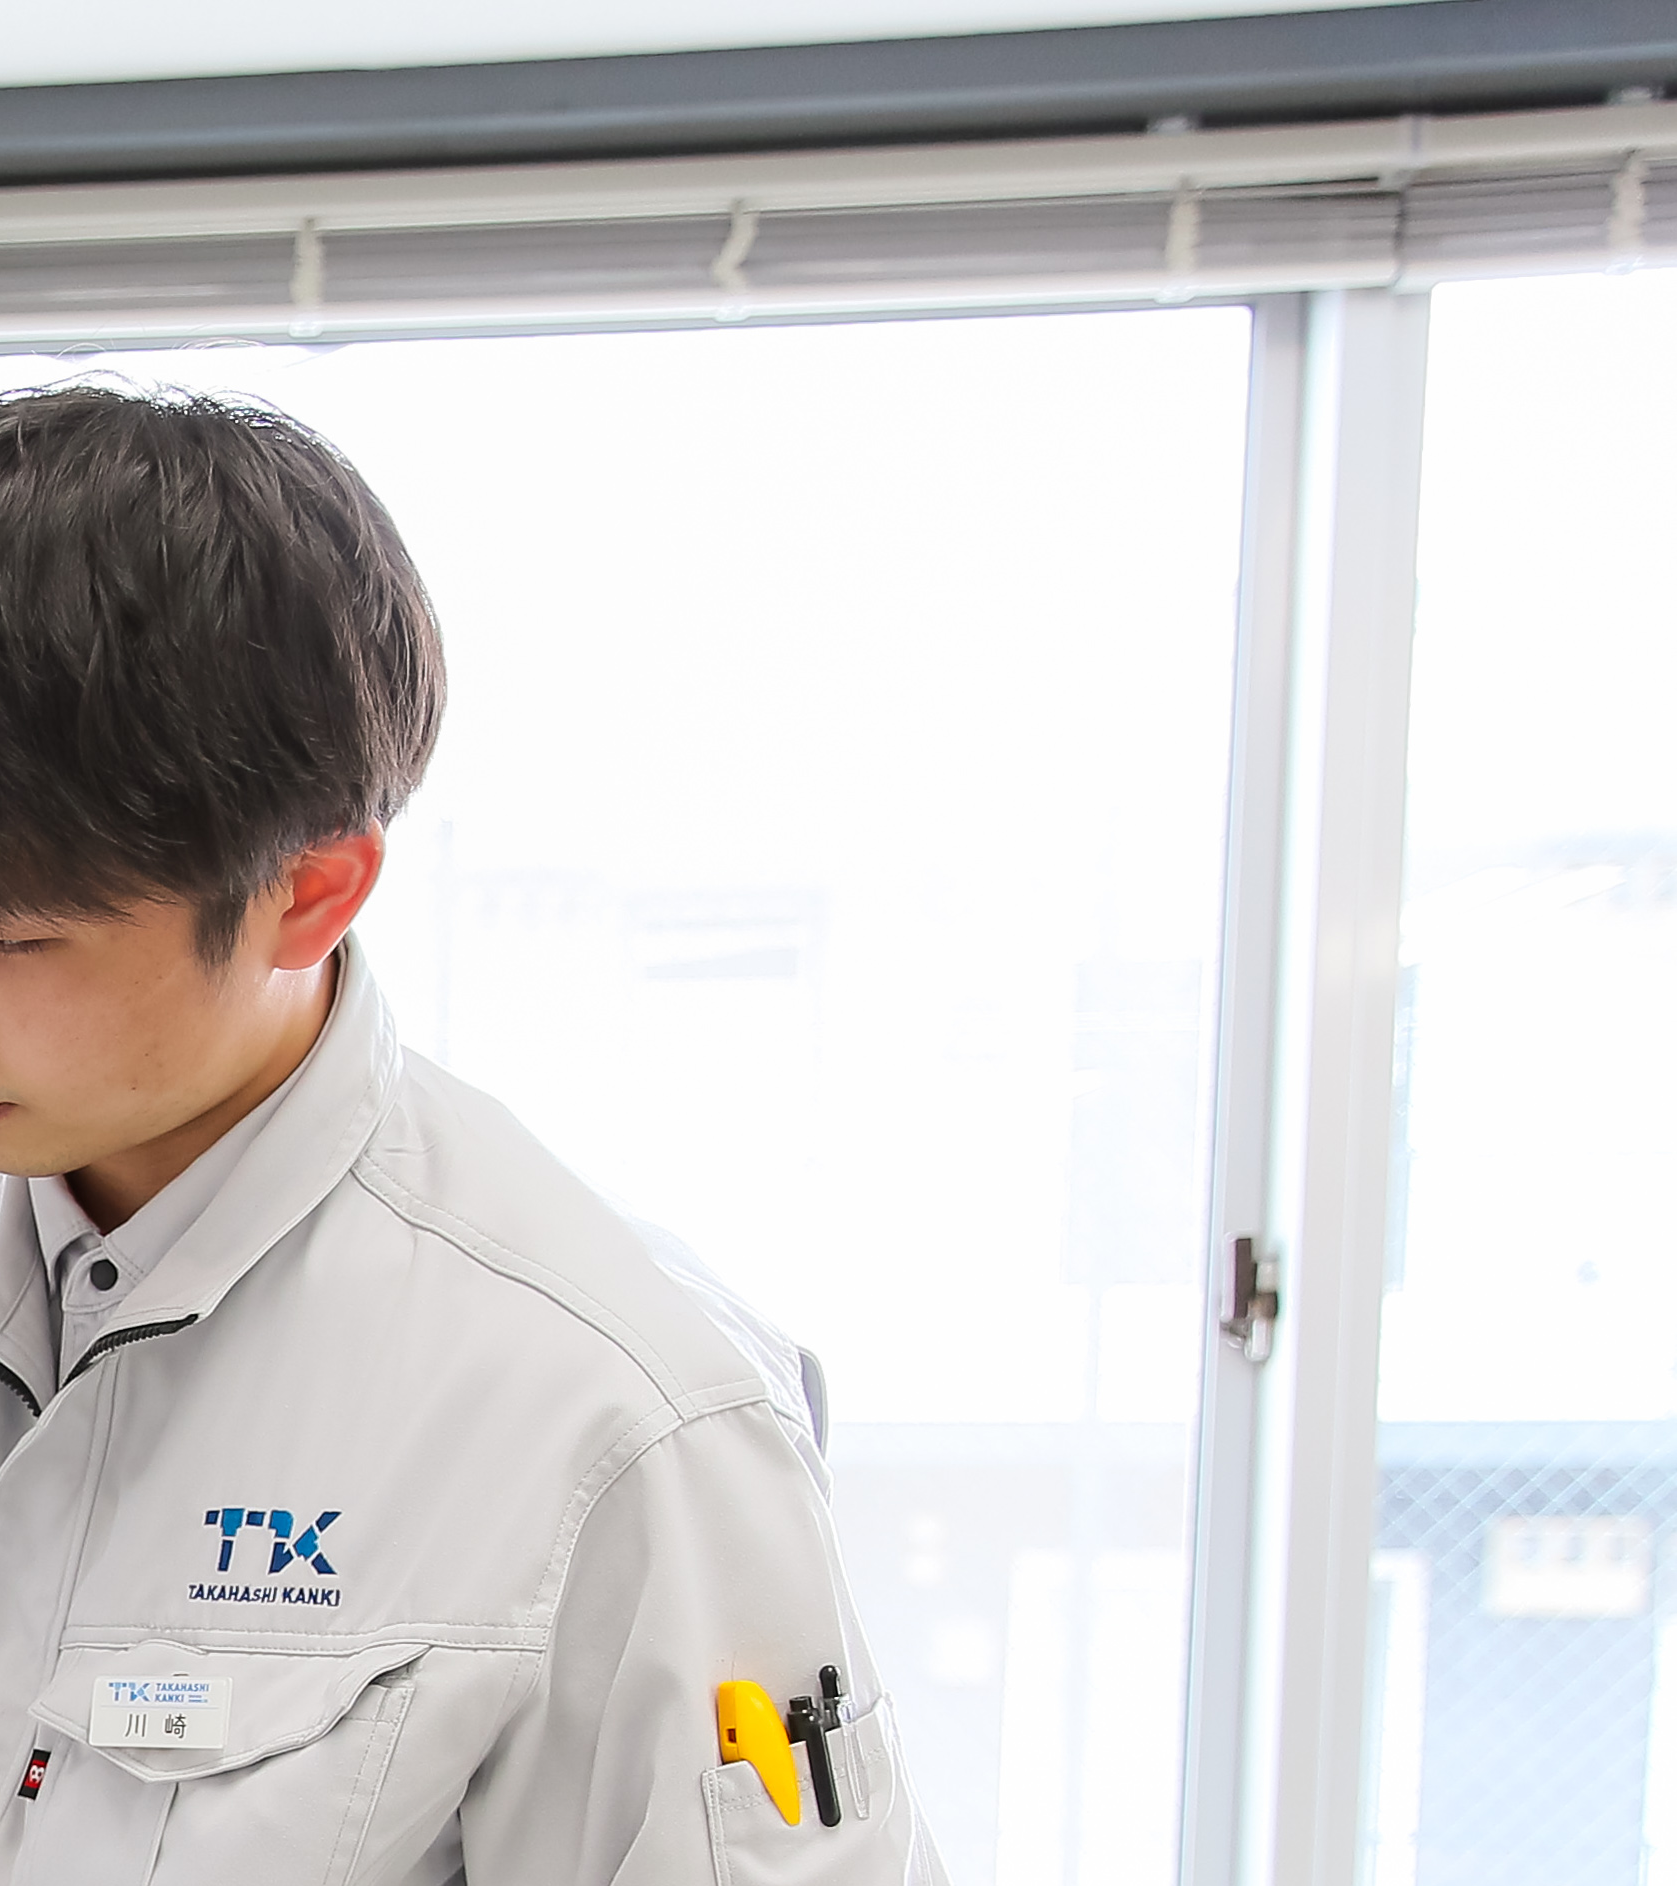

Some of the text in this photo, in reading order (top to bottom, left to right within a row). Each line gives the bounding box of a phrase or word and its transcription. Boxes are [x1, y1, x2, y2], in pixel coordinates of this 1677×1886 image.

[188, 1584, 341, 1607] TAKAHASHI KANKI
[155, 1682, 209, 1692] TAKAHASHI
[155, 1694, 185, 1703] KANKI
